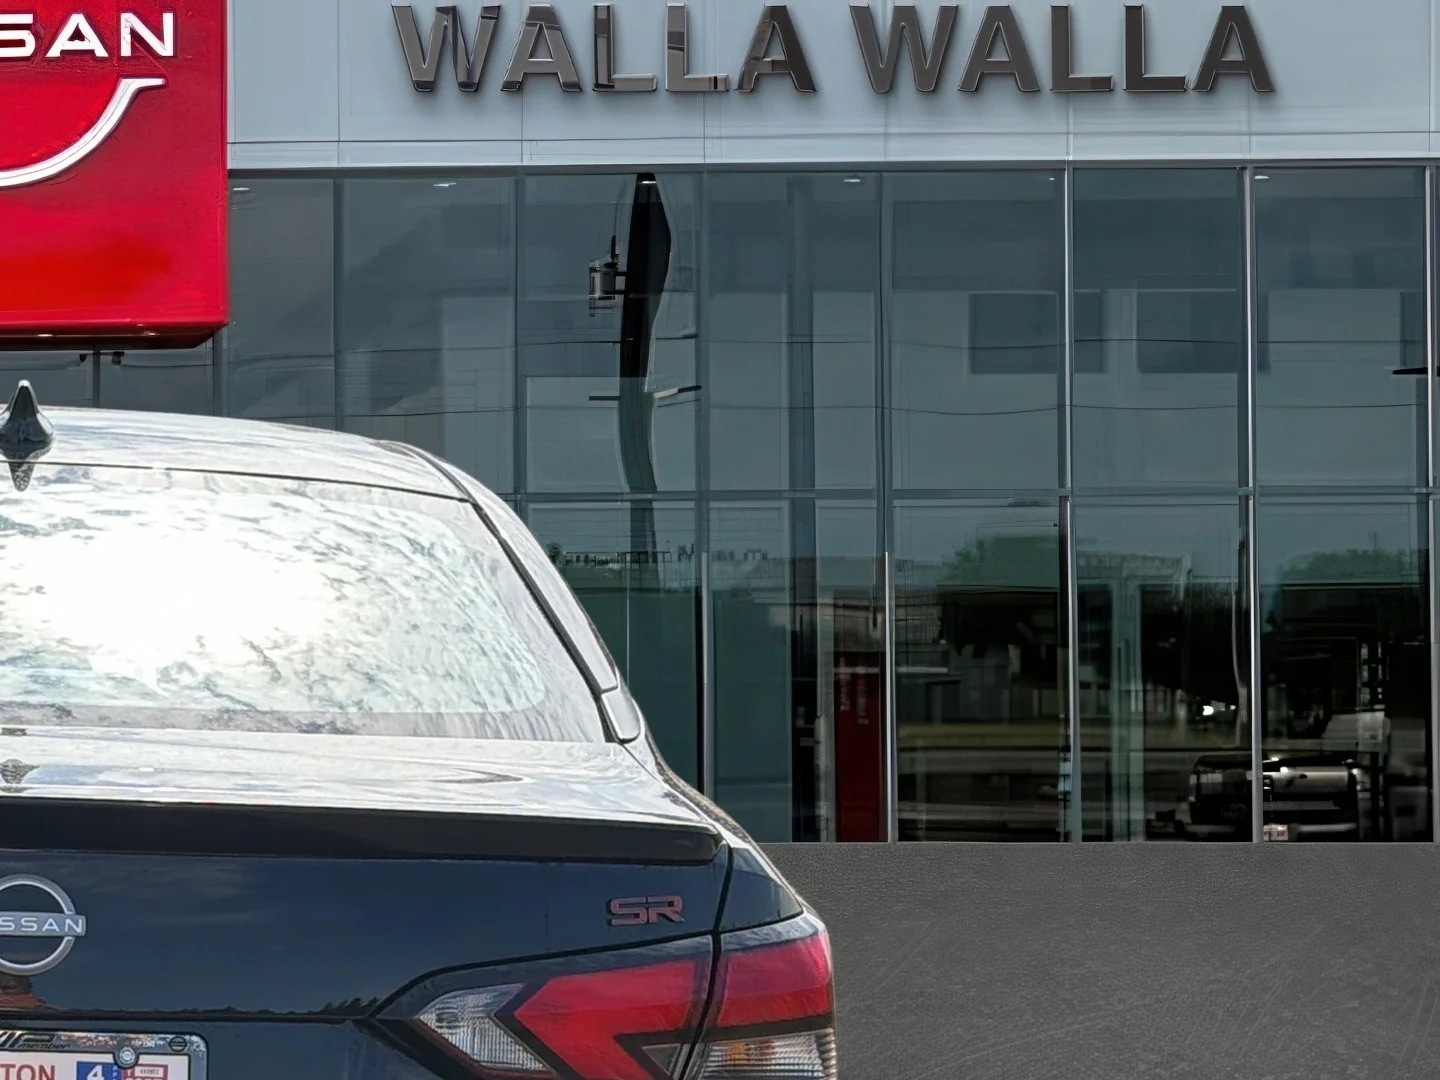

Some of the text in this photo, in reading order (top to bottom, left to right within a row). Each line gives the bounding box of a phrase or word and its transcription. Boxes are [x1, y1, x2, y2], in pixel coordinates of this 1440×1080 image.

[390, 3, 1275, 94] WALLA WALLA
[608, 895, 685, 926] SR
